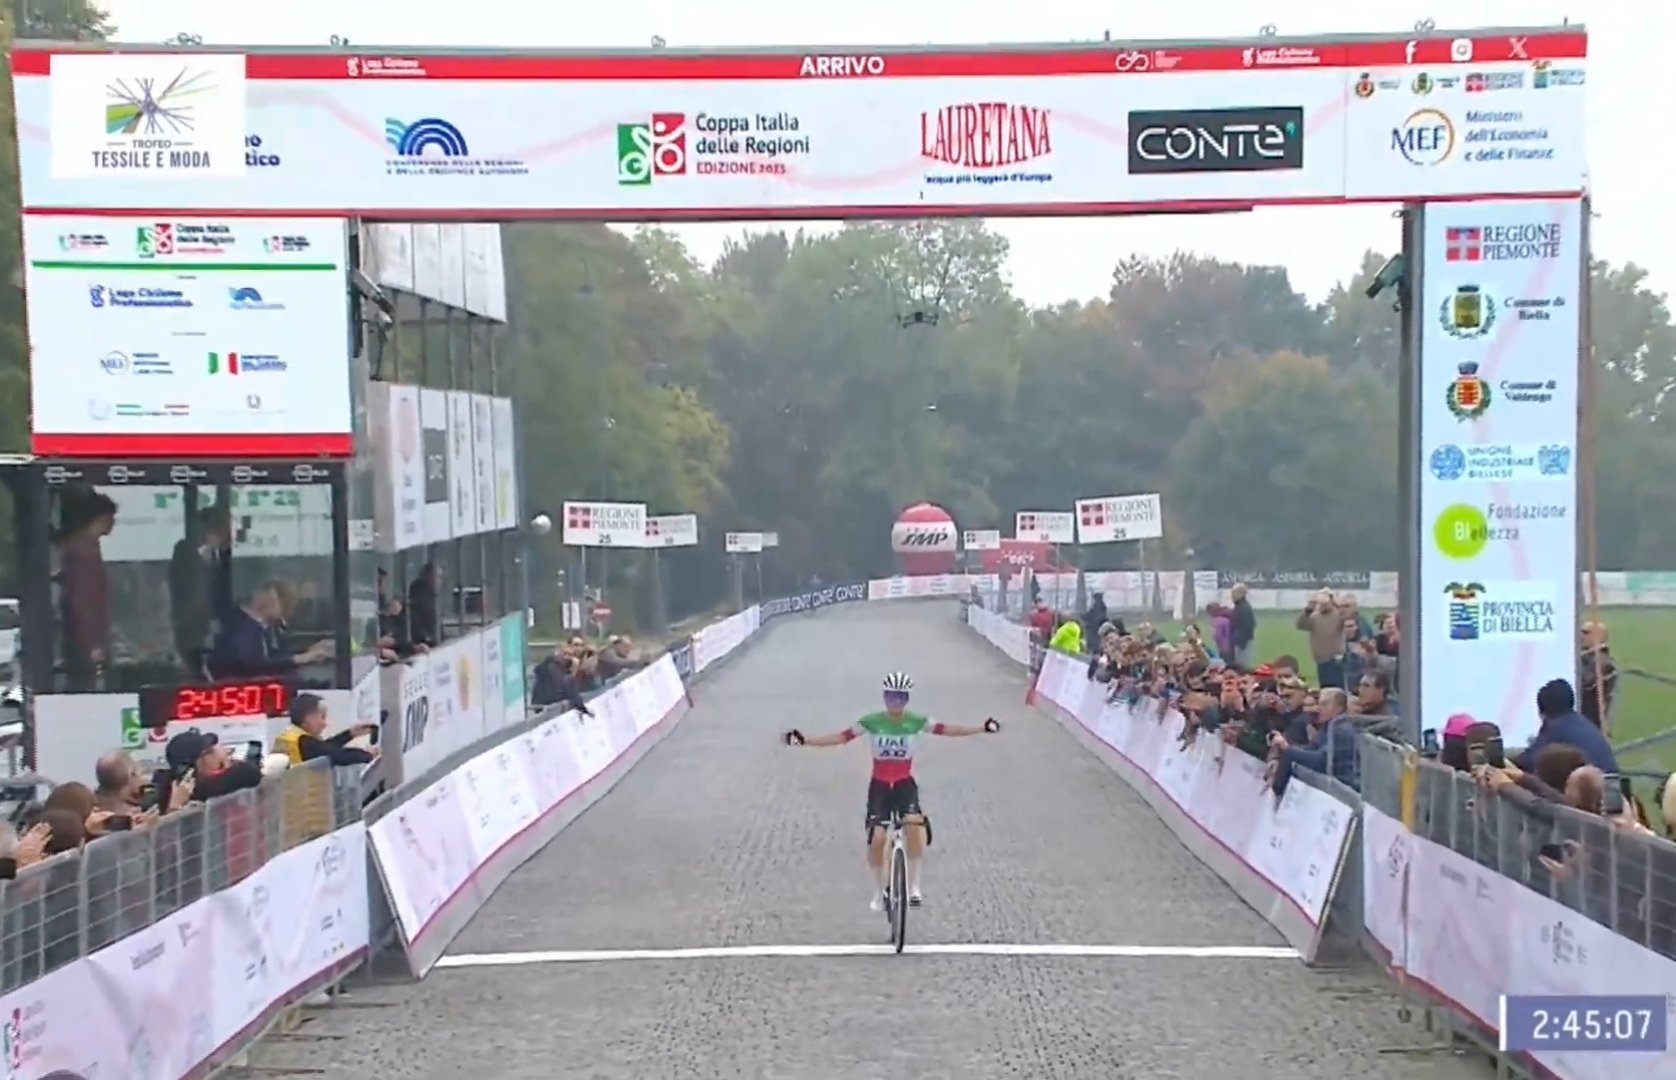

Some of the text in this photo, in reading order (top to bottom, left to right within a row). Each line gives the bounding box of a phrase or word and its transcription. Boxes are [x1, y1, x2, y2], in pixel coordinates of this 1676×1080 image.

[800, 56, 885, 76] ARRIVO
[696, 112, 799, 136] Coppa Italia
[920, 102, 1052, 168] LAURETANA
[1391, 125, 1447, 151] MEF
[696, 136, 809, 158] delle Regioni
[696, 162, 756, 175] EDIZIONE
[1482, 223, 1562, 242] REGIONE
[1482, 242, 1561, 260] PIEMONTE
[1487, 502, 1567, 519] Fondazione
[599, 533, 612, 544] 25
[900, 532, 949, 546] SMP
[1113, 528, 1127, 539] 25
[1482, 602, 1554, 617] PROVINCIA
[1482, 617, 1554, 633] DI BIELLA
[177, 684, 285, 719] 2:45:07
